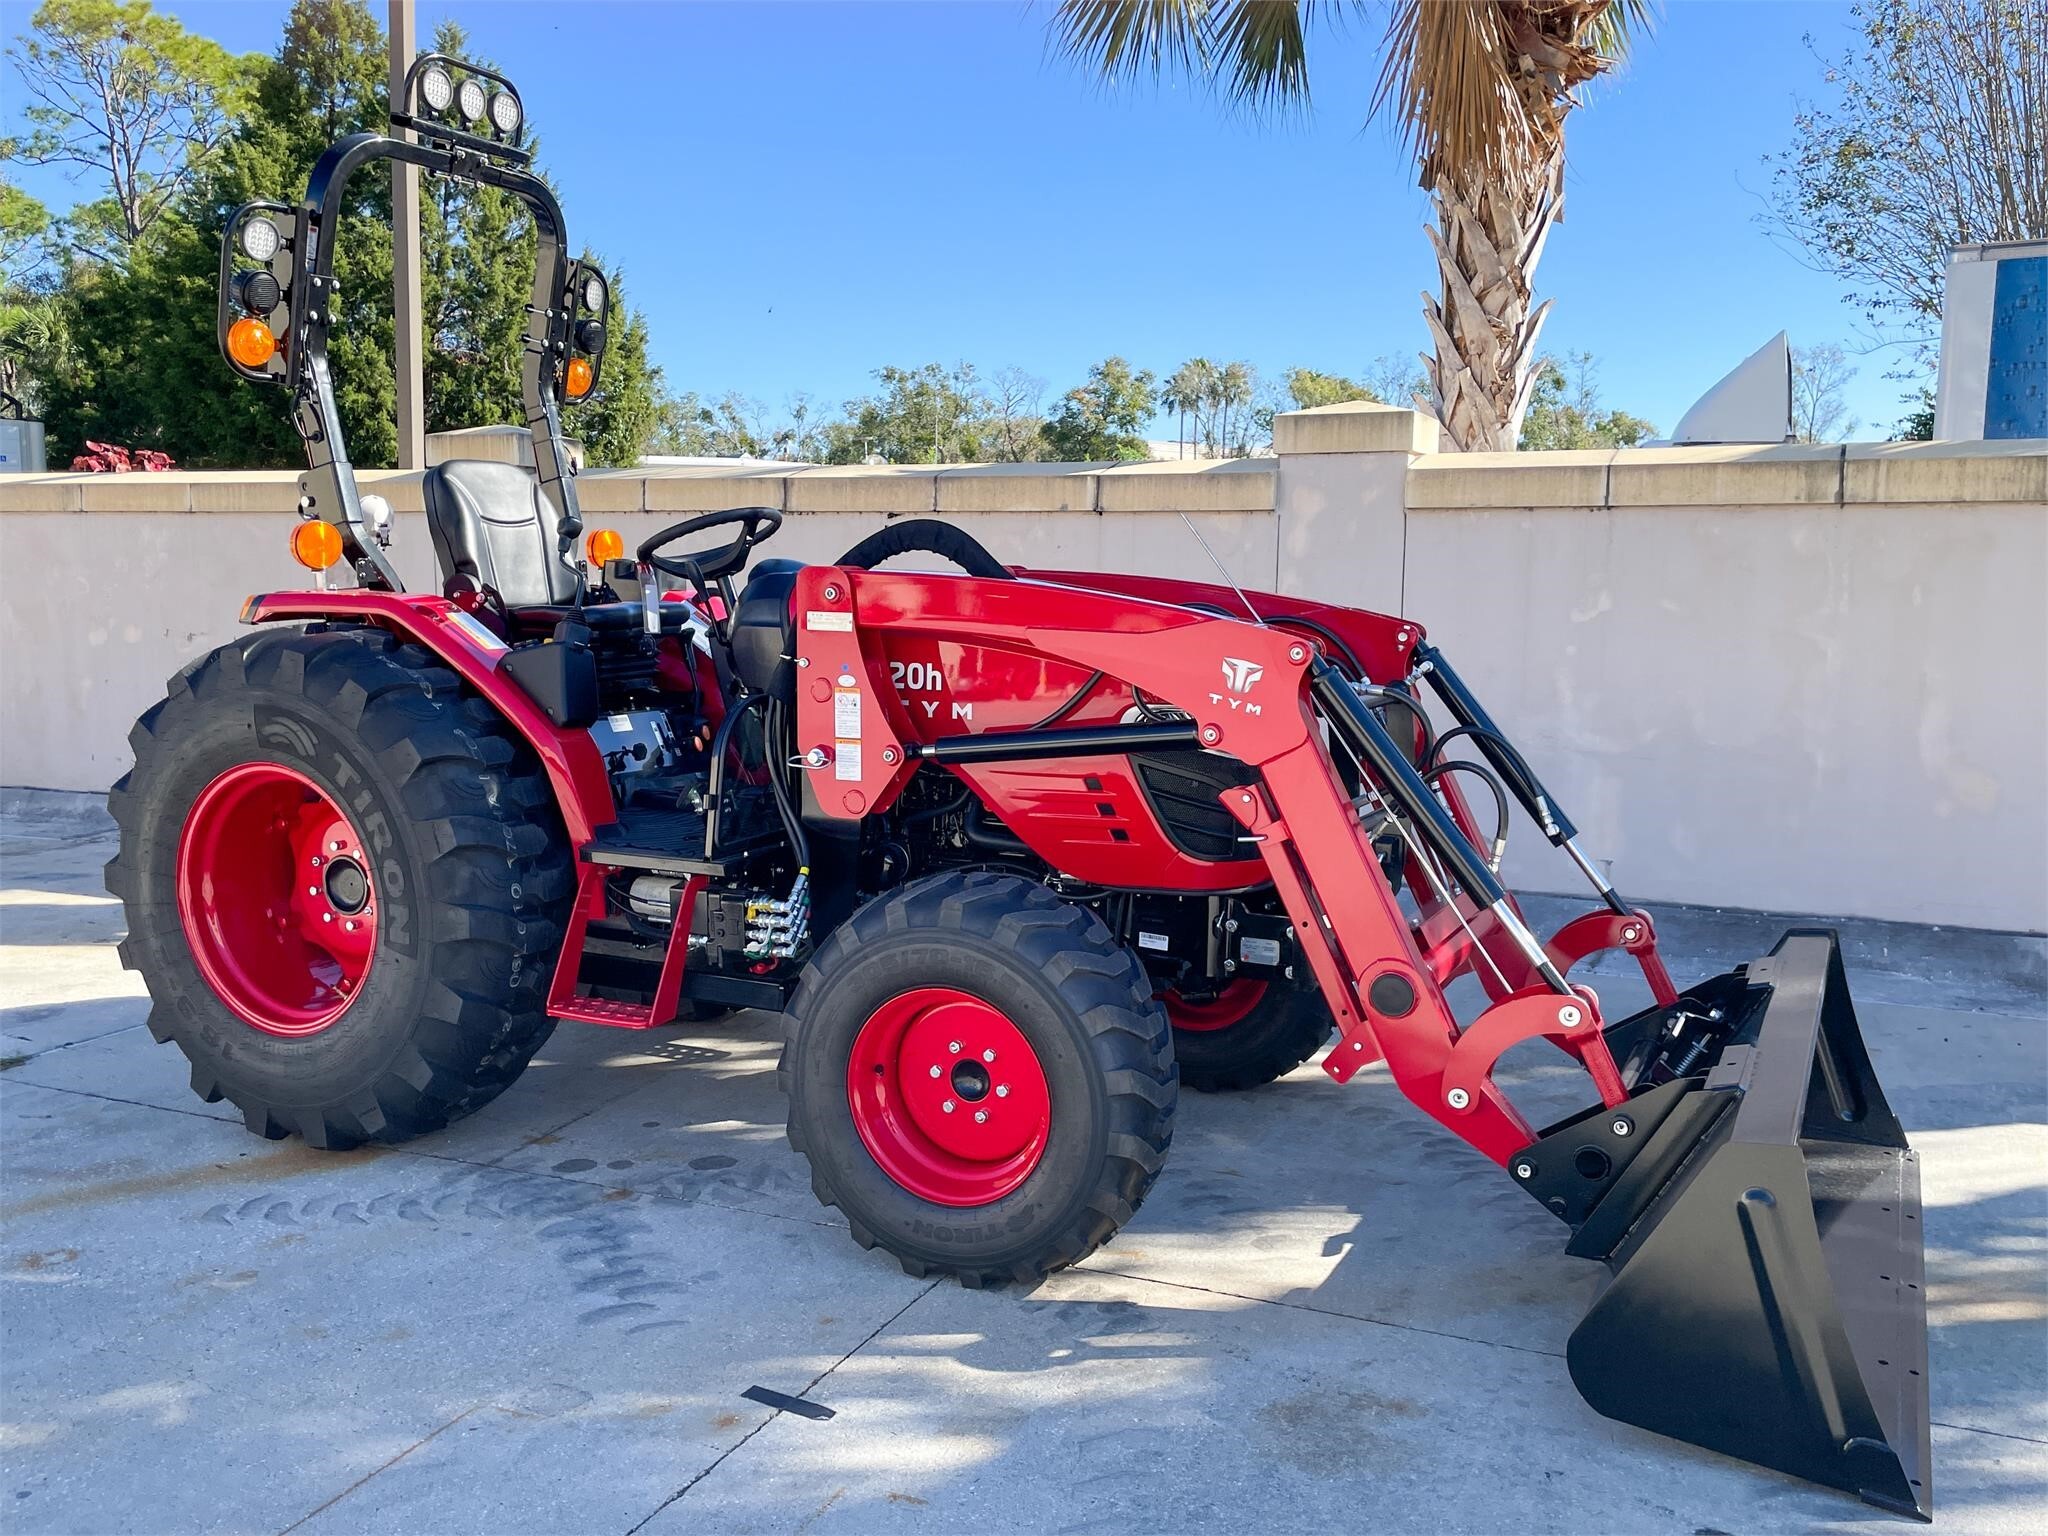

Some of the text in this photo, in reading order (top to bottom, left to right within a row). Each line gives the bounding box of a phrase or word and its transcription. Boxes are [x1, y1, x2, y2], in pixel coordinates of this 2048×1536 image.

[900, 699, 973, 720] YM
[1208, 693, 1262, 716] TYM
[335, 752, 411, 945] TIRON
